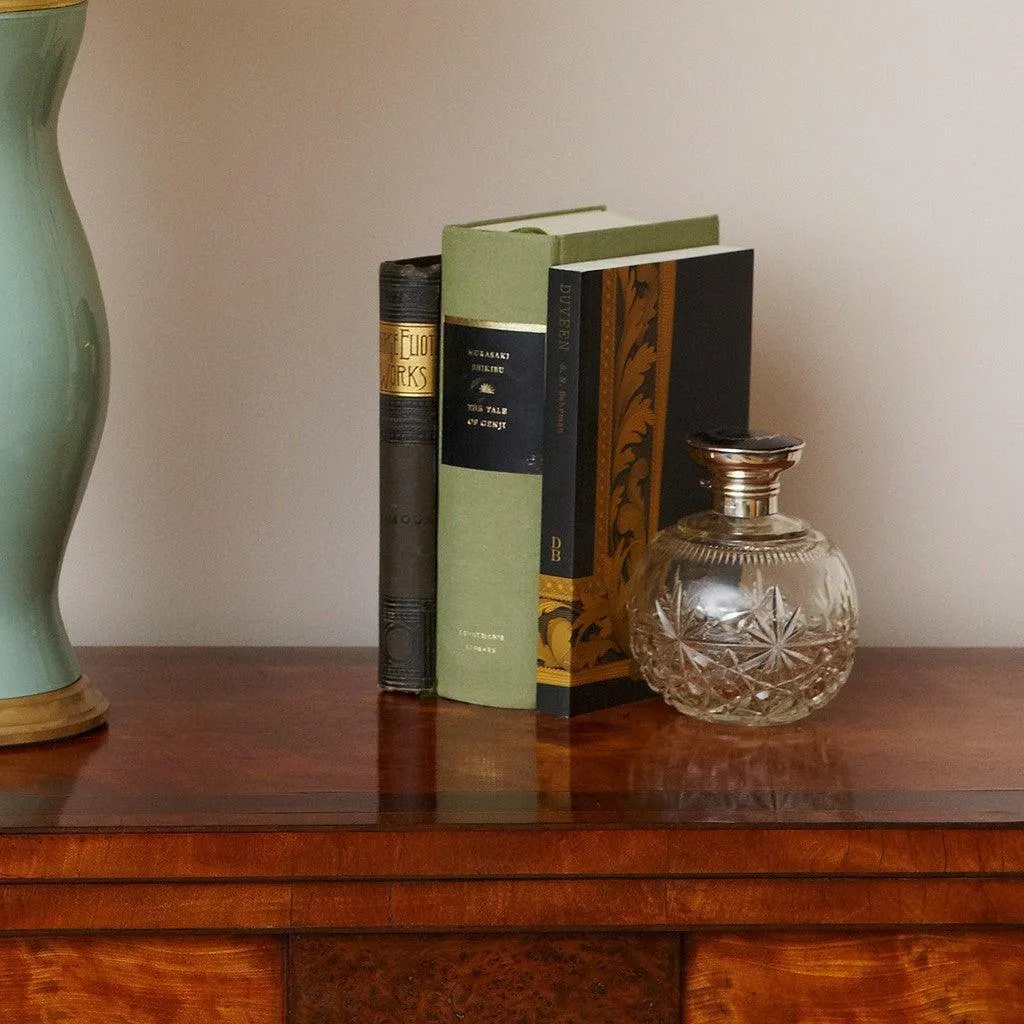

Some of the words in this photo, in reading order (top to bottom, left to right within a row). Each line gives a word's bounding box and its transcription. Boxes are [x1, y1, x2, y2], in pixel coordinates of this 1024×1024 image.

[558, 284, 572, 352] DUVEEN
[486, 405, 508, 415] TALE
[467, 418, 478, 426] OF
[480, 420, 507, 430] GENJI
[551, 536, 562, 549] D
[550, 549, 562, 562] B
